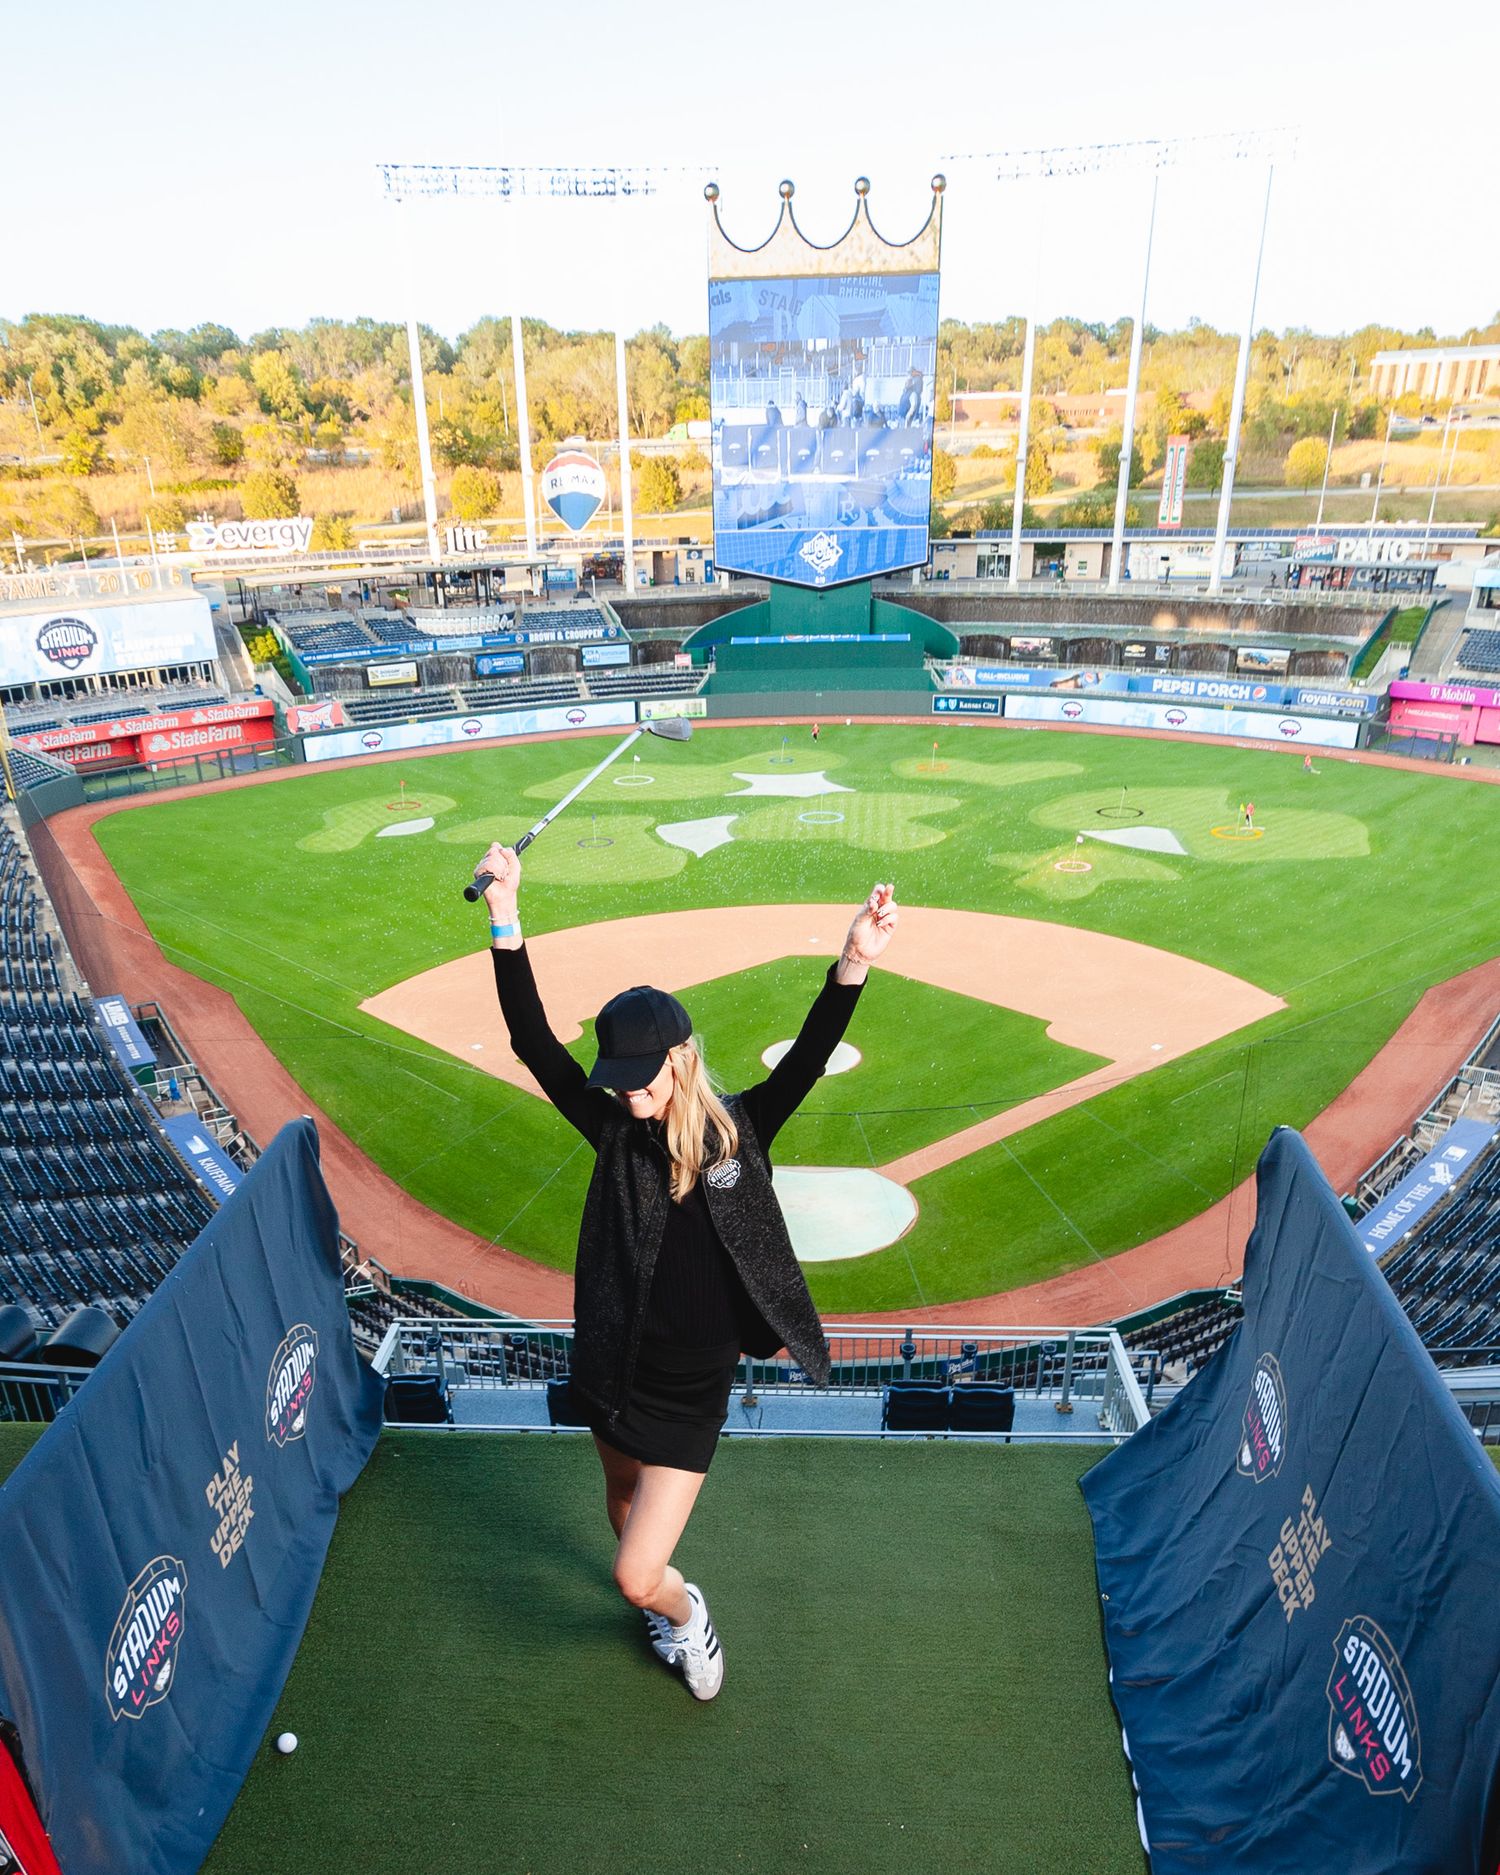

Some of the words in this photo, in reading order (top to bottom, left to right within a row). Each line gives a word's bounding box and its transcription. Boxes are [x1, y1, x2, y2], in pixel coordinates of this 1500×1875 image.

[221, 522, 311, 549] evergy
[1294, 543, 1334, 560] CHOPPER
[1337, 537, 1409, 562] PATIO
[98, 573, 120, 593] 20
[133, 571, 153, 589] 10
[1306, 566, 1348, 586] PRIC
[39, 624, 95, 650] STADIUM
[49, 645, 90, 660] LINKS
[529, 631, 553, 643] BROWN
[958, 701, 981, 709] Kansas
[983, 702, 996, 712] City
[1152, 678, 1194, 695] PEPSI
[1197, 681, 1250, 700] PORCH
[1301, 693, 1365, 709] royals.com
[198, 1157, 237, 1196] KAUFFMAN
[1405, 1183, 1434, 1201] THE
[1368, 1210, 1406, 1240] HOME
[1395, 1199, 1417, 1214] OF
[270, 1341, 314, 1427] STADIUM
[279, 1371, 312, 1437] LINKS
[1254, 1369, 1283, 1462] STADIUM
[1247, 1405, 1270, 1472] LINKS
[206, 1440, 240, 1506] PLAY
[215, 1467, 243, 1516] THE
[210, 1475, 254, 1555] UPPER
[1301, 1483, 1332, 1551] PLAY
[220, 1505, 256, 1570] DECK
[1299, 1513, 1321, 1574] THE
[1268, 1541, 1300, 1624] DECK
[1280, 1517, 1316, 1611] UPPER
[113, 1576, 180, 1700] STADIUM
[131, 1611, 180, 1706] LINKS
[1335, 1674, 1391, 1783] LINKS
[1343, 1634, 1413, 1780] STADIUM
